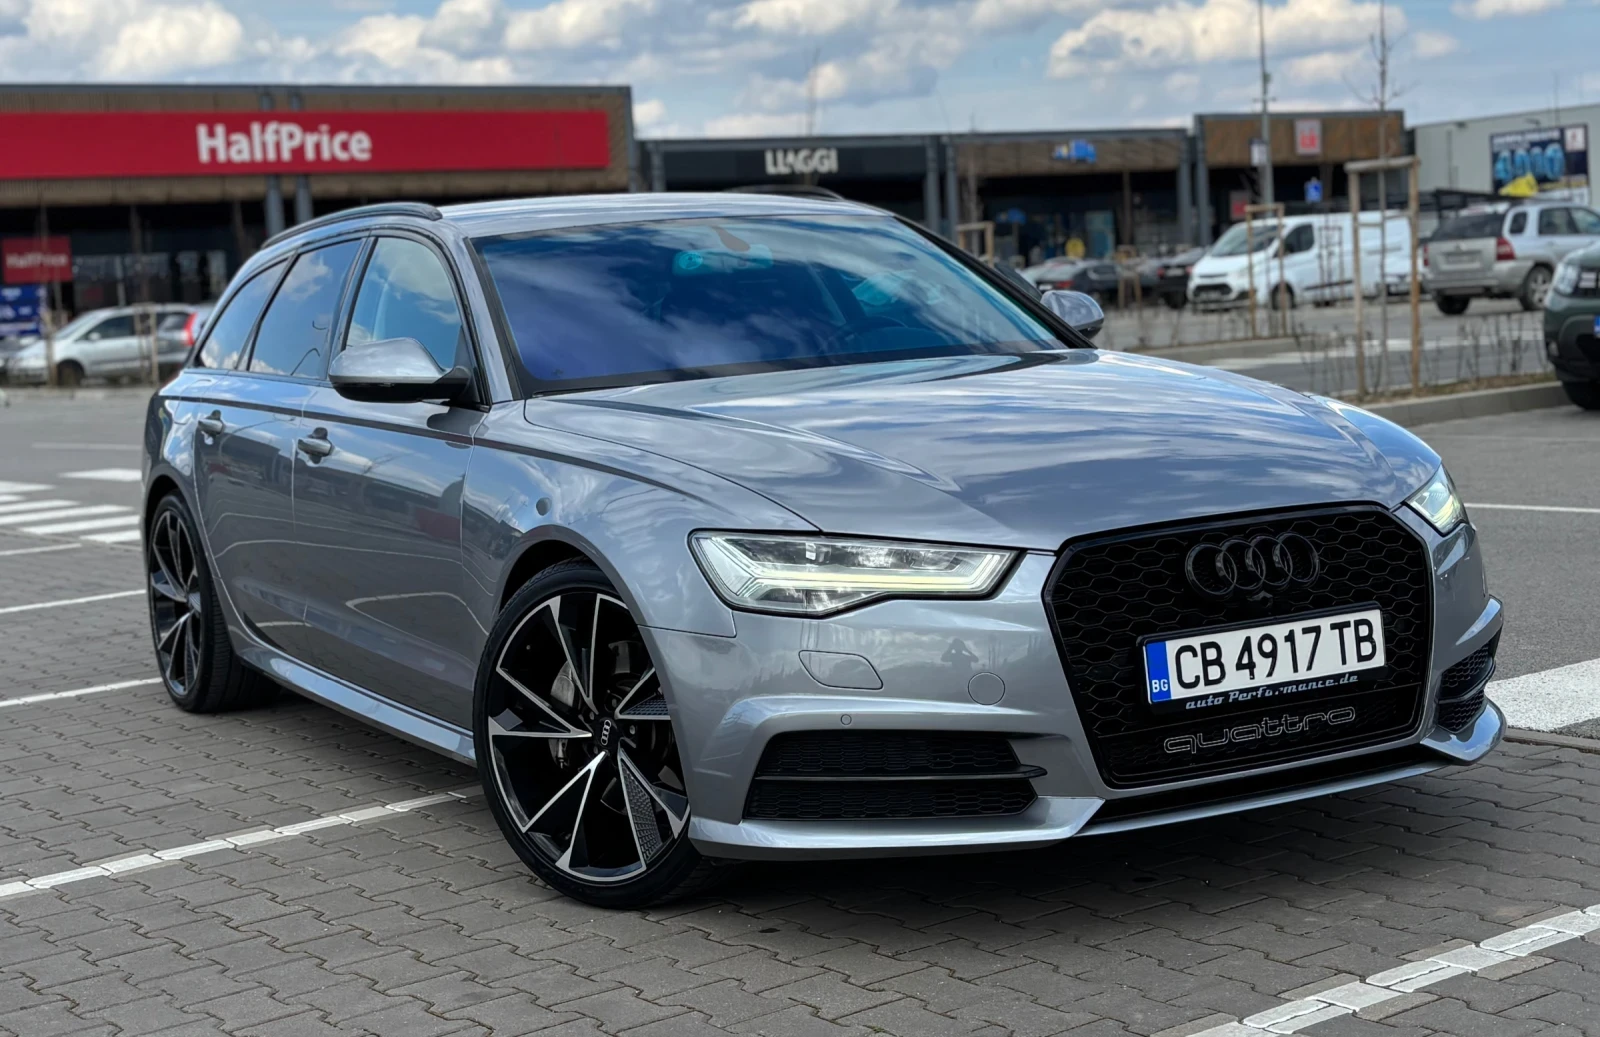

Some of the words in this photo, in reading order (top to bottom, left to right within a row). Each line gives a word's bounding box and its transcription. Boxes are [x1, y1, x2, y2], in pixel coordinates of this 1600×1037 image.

[196, 121, 372, 164] HalfPrice
[1174, 641, 1227, 690] CB
[1235, 625, 1322, 680] 4917
[1330, 618, 1378, 664] TB
[1152, 679, 1168, 693] BG
[1185, 696, 1224, 710] auto
[1164, 706, 1355, 754] quattro
